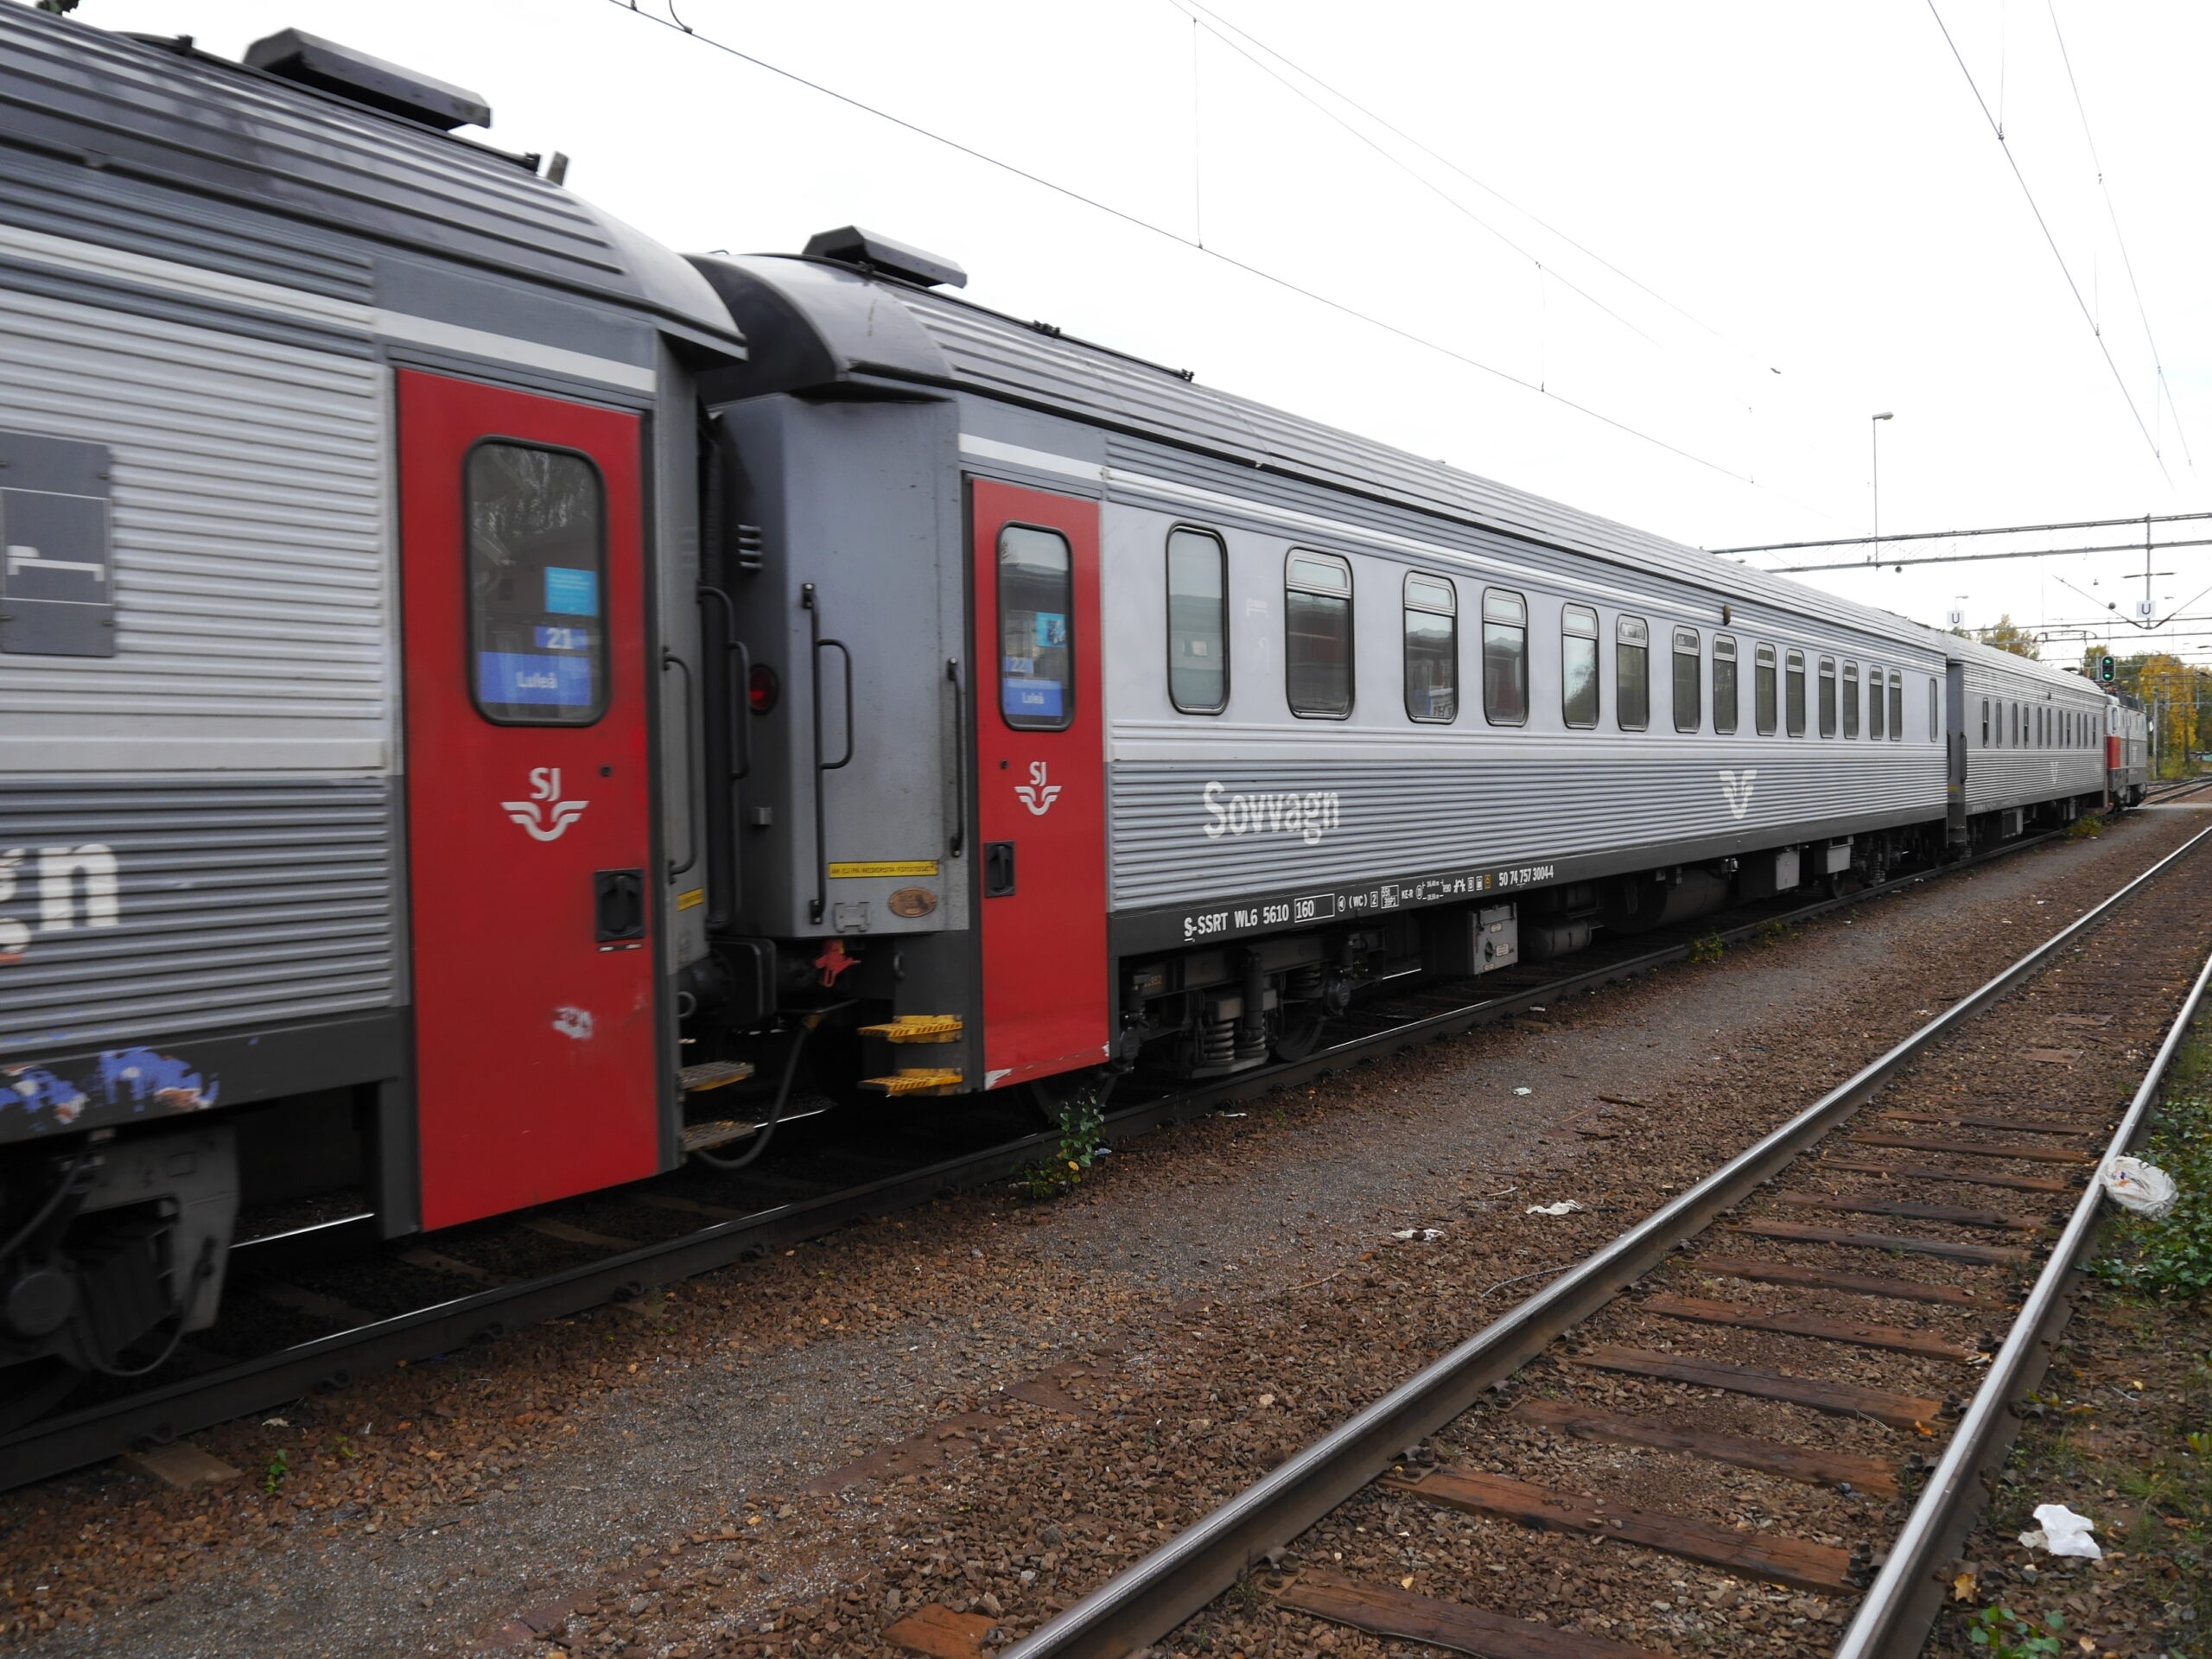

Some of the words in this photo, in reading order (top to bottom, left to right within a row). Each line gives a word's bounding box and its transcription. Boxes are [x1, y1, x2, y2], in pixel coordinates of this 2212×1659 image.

[1951, 612, 1961, 624] U
[2141, 603, 2152, 615] U
[546, 627, 574, 649] 21
[1010, 657, 1027, 672] 22
[516, 671, 558, 690] Luleå
[1021, 691, 1044, 705] Luleå
[1029, 761, 1047, 786] SJ
[528, 767, 561, 802] SJ
[1499, 872, 1508, 887] 50
[1510, 870, 1518, 884] 74
[1184, 912, 1228, 938] S-SSRT
[1234, 908, 1258, 928] WL6
[1262, 904, 1290, 925] 5610
[1295, 899, 1315, 918] 160
[1371, 895, 1377, 906] 2
